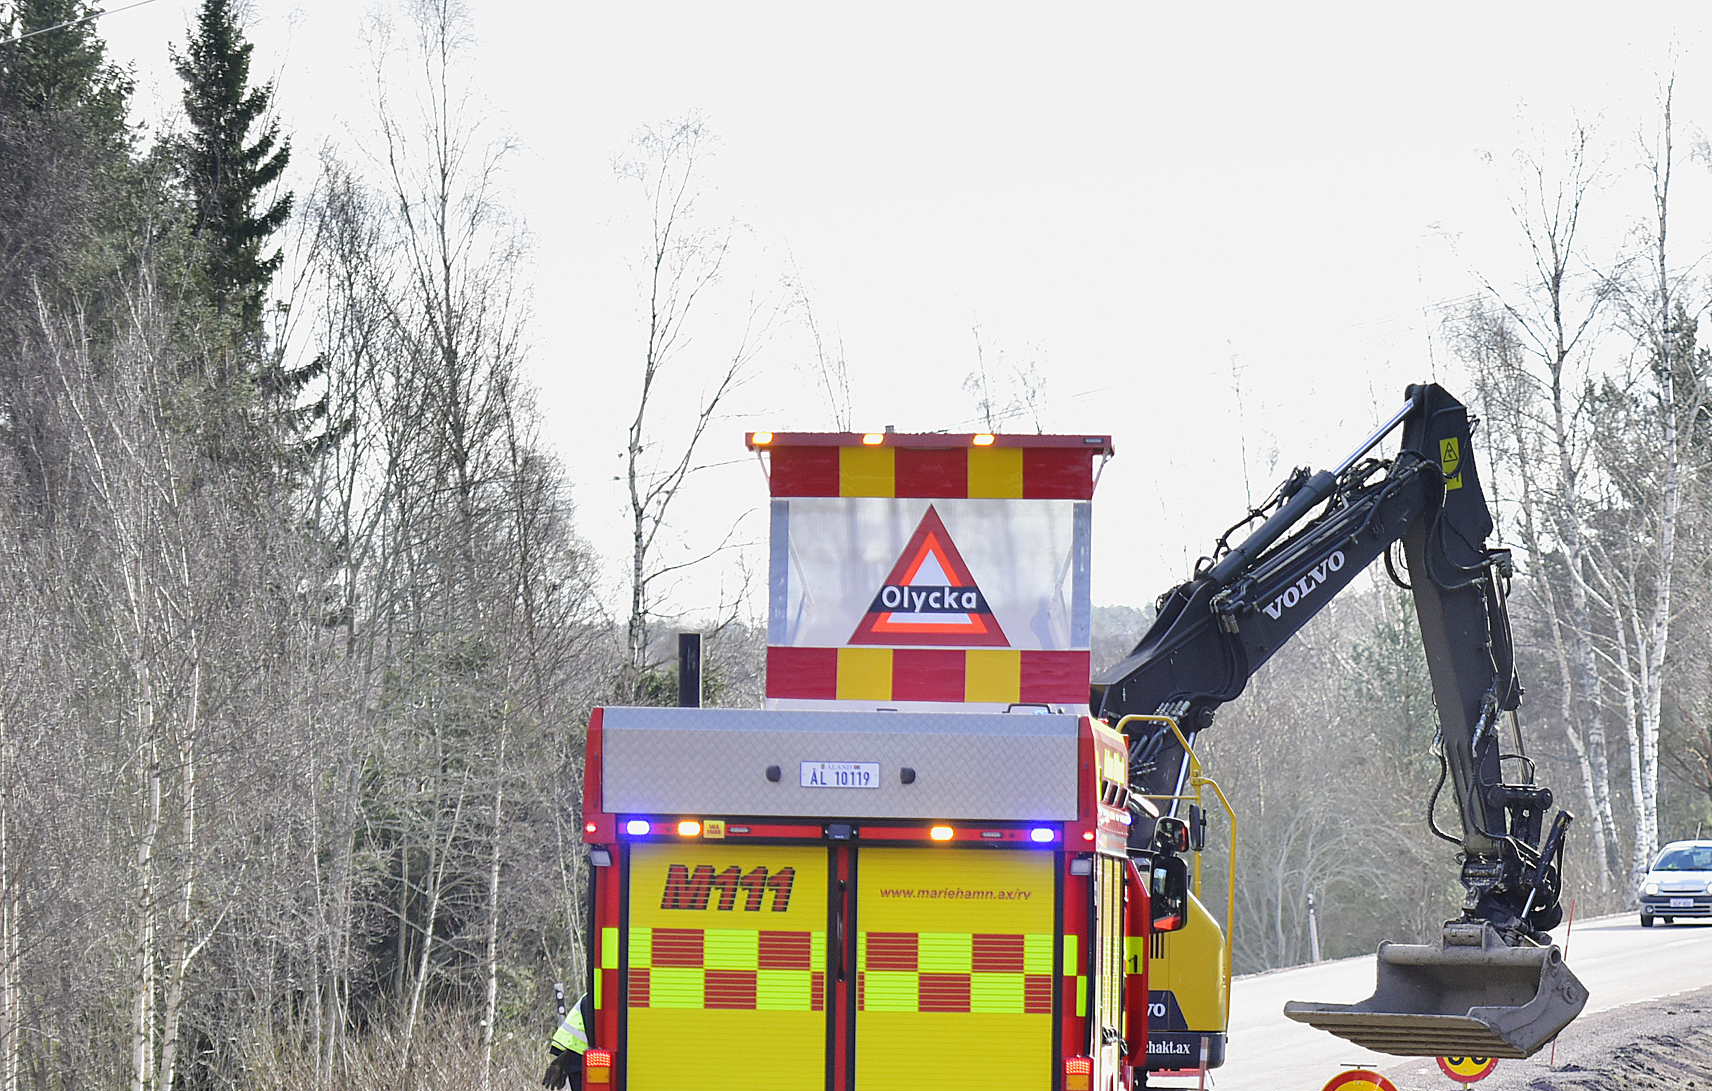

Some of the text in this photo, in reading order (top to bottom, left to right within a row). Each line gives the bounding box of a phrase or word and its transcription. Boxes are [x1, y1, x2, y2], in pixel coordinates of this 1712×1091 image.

[881, 585, 977, 613] Olycka
[1262, 550, 1345, 620] VOLVO
[810, 768, 870, 786] ÅL 10119
[660, 864, 796, 912] M111
[880, 887, 1032, 900] www.mariehamn.ax/rv
